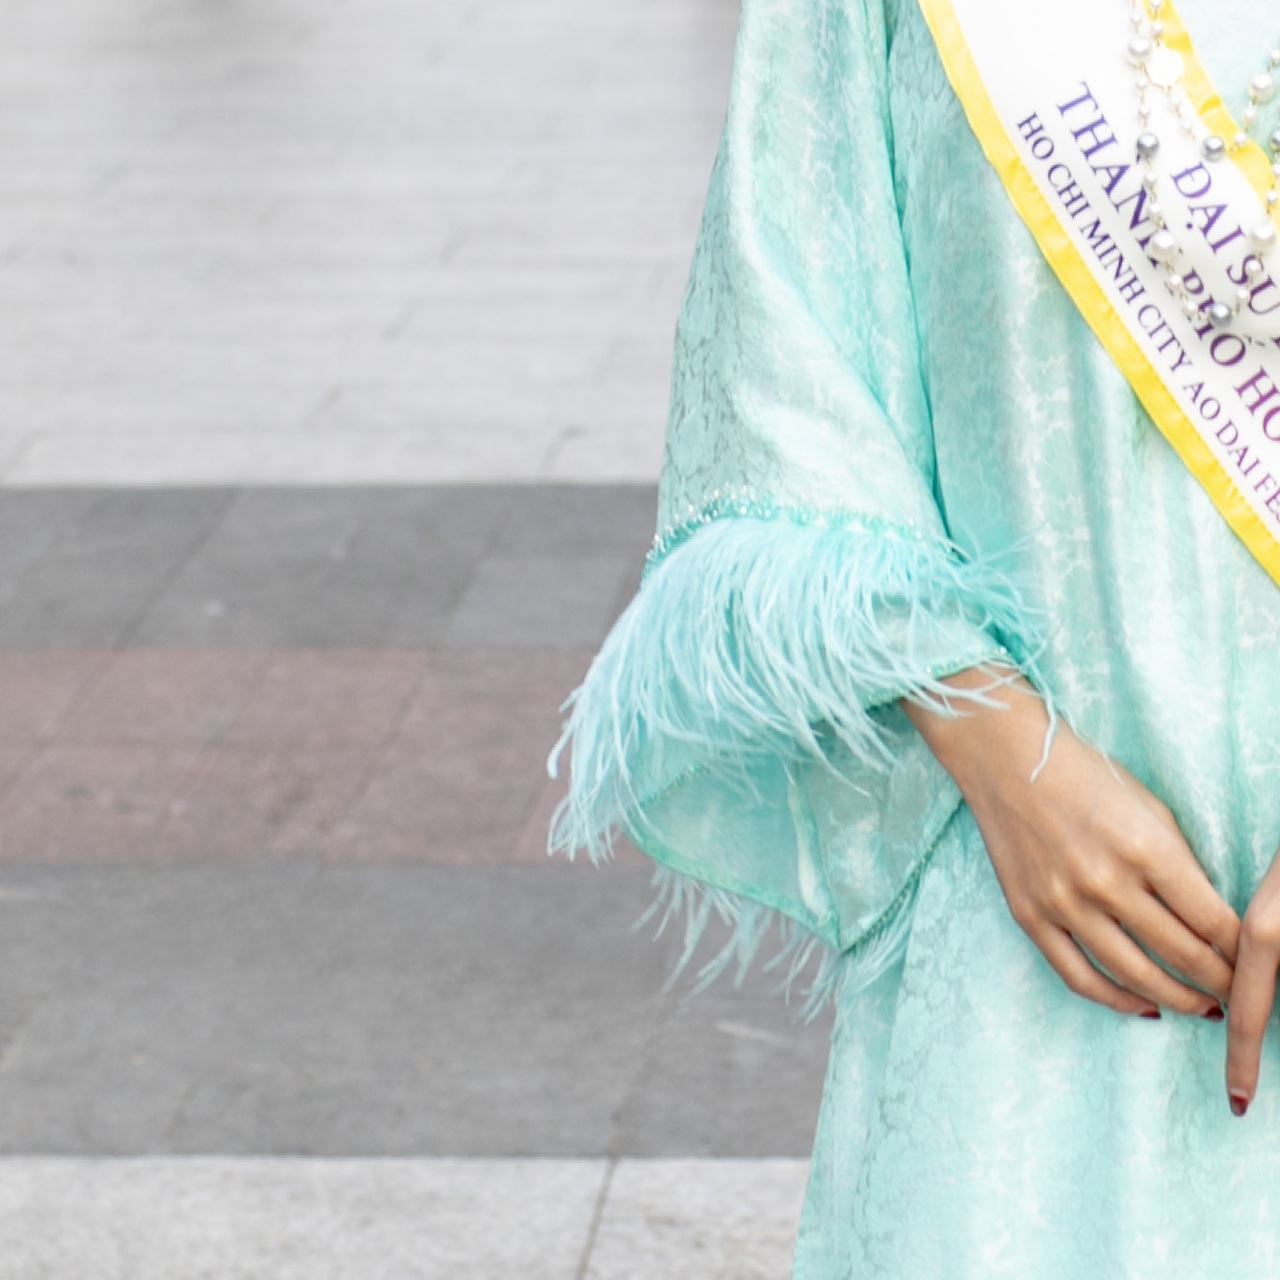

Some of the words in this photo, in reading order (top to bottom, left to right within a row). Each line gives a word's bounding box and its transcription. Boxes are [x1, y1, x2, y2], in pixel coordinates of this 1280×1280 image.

[1017, 111, 1055, 160] HO
[1047, 163, 1091, 219] CHI
[1079, 216, 1146, 304] MINH
[1138, 304, 1193, 373] CITY
[1183, 381, 1221, 420] AO
[1215, 419, 1261, 478] DAI
[1170, 160, 1245, 255] ĐẠI
